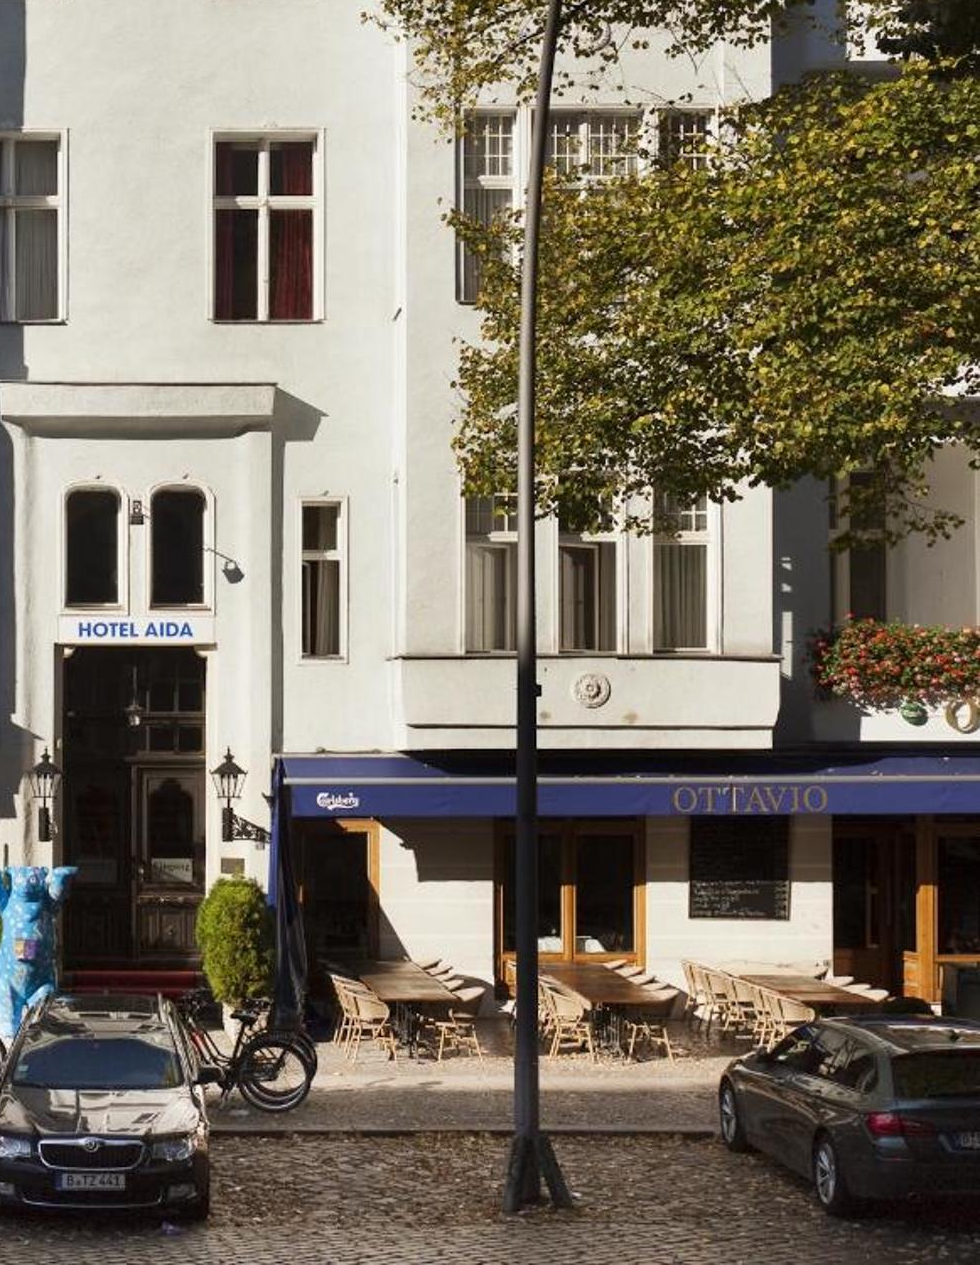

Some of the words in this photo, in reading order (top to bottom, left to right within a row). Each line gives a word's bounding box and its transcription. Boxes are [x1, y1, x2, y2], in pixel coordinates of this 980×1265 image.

[78, 621, 139, 637] HOTEL
[144, 621, 194, 637] AIDA
[673, 785, 829, 813] OTTAVIO
